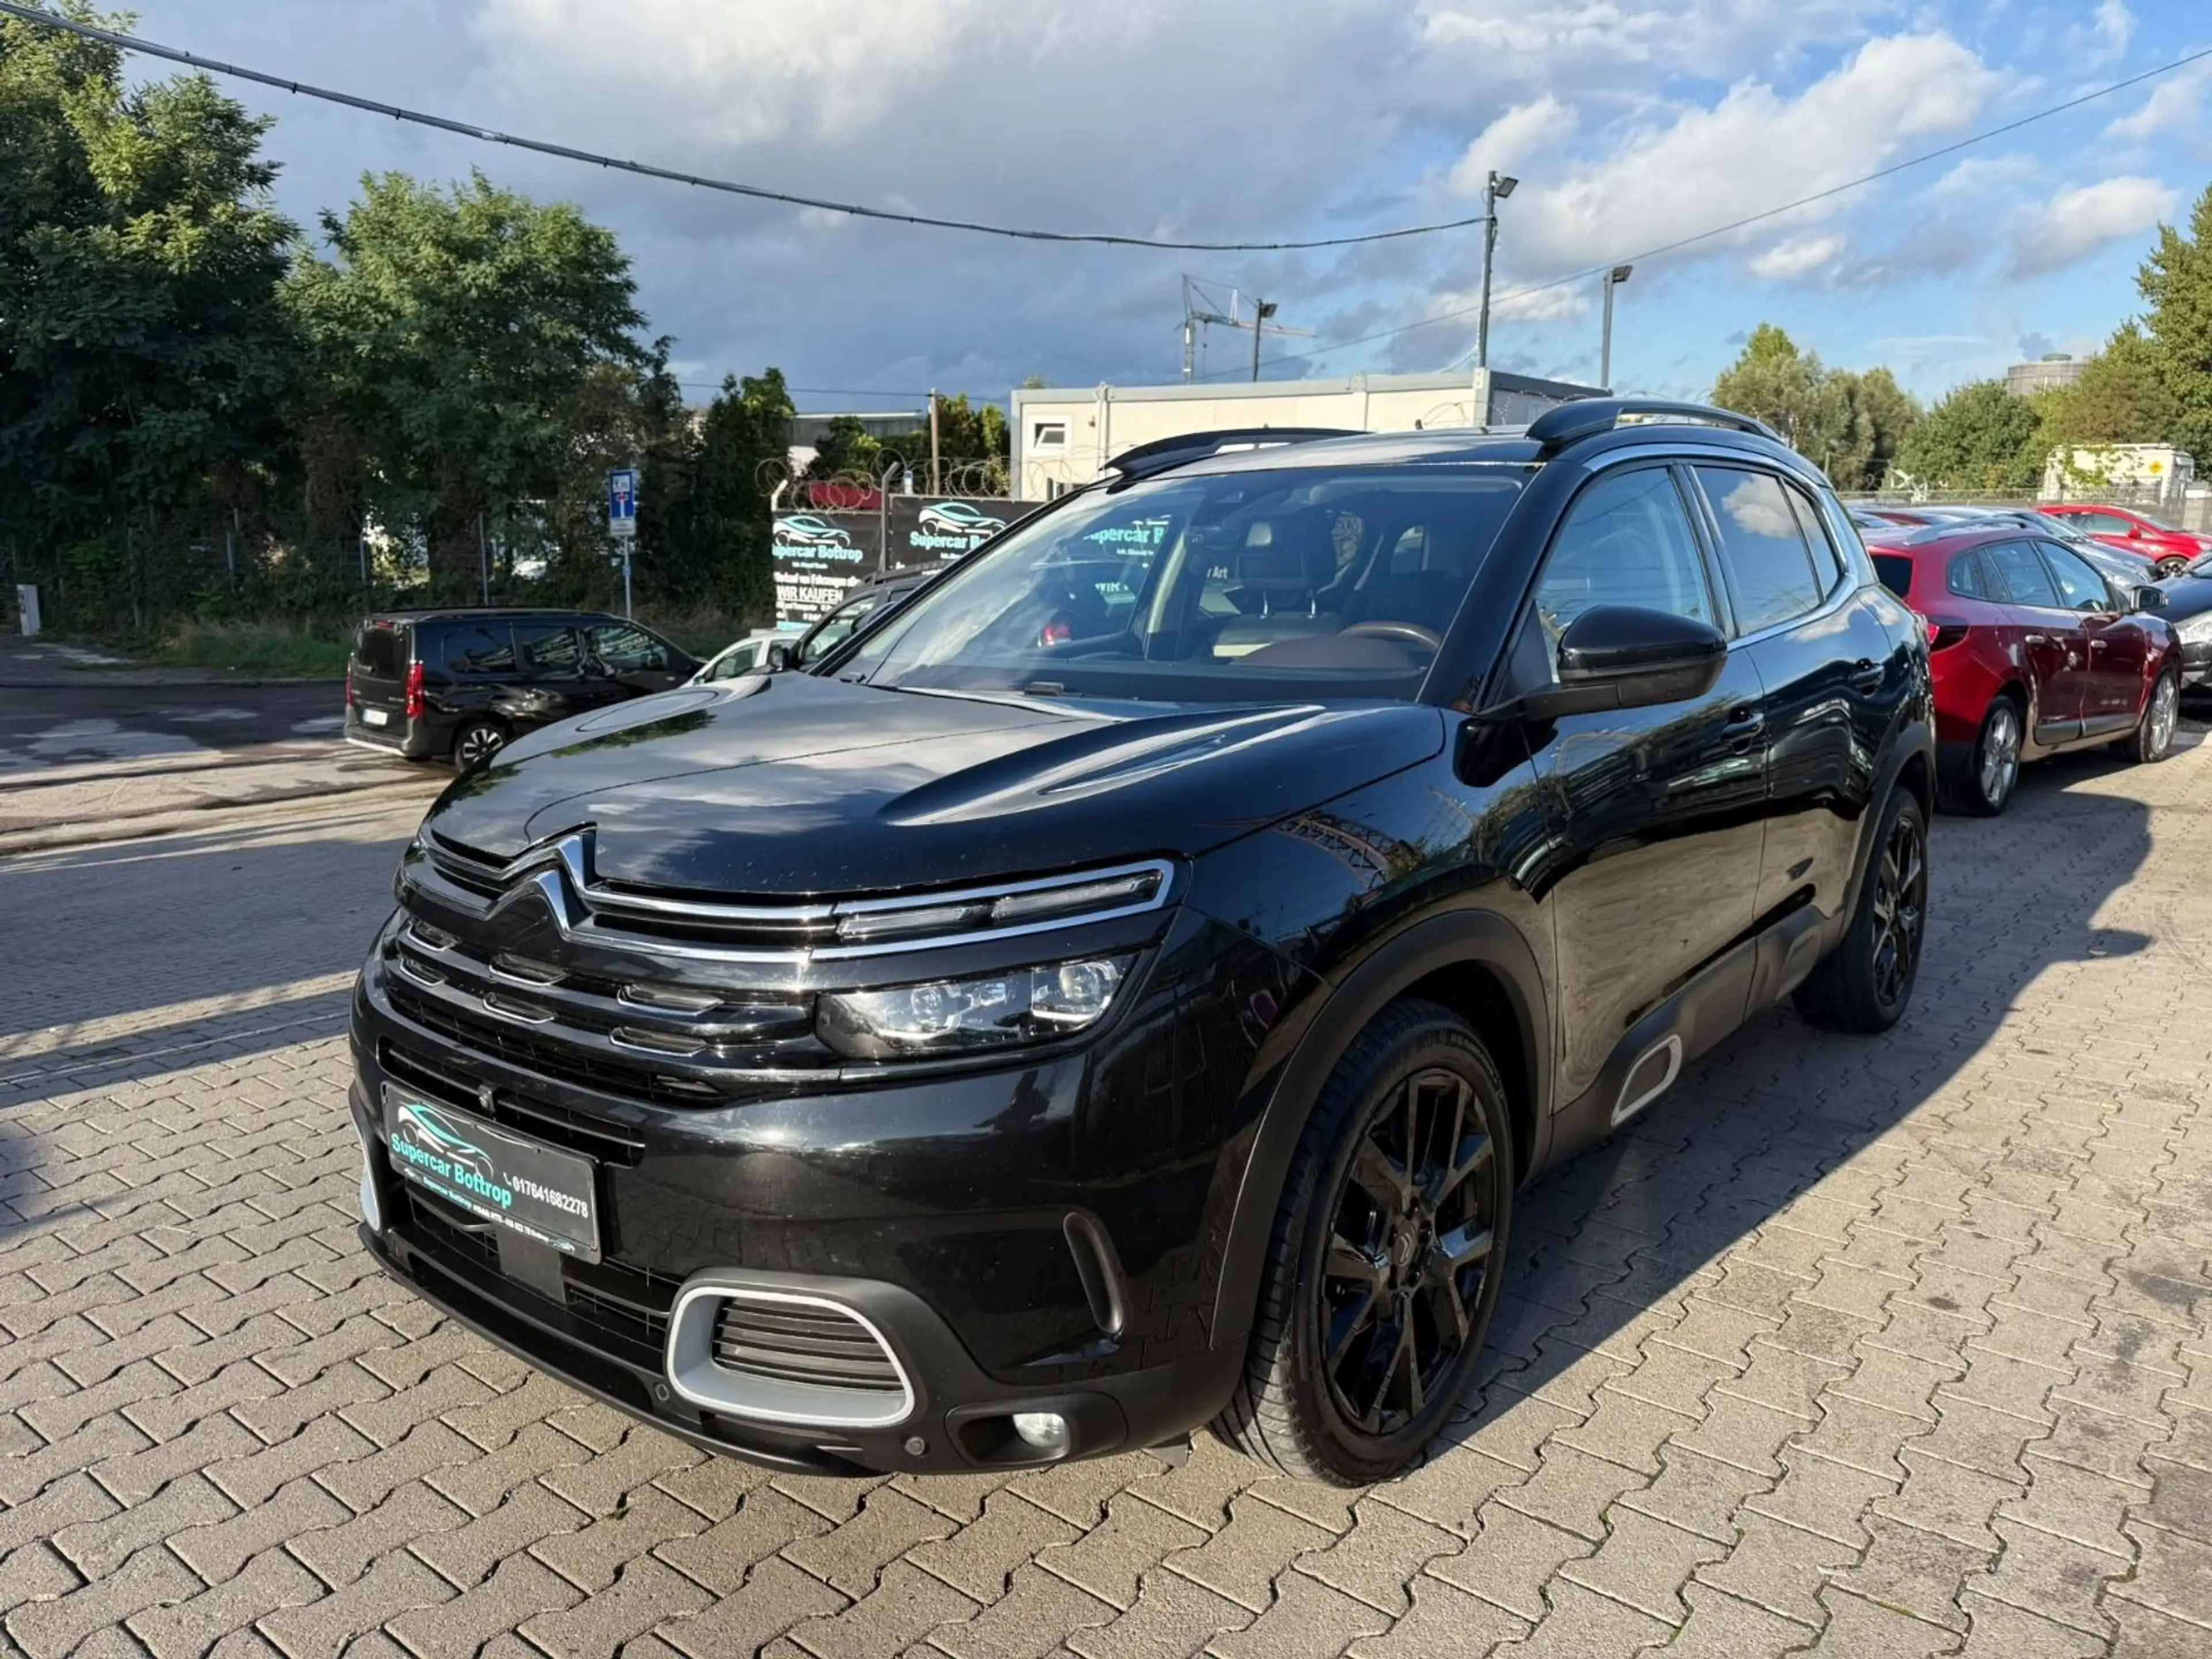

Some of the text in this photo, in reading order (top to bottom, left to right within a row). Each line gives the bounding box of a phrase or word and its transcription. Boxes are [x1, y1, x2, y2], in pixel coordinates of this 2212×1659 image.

[910, 531, 968, 550] Supercar
[818, 545, 863, 563] Bottrop
[777, 585, 844, 604] WIR KAUFEN
[391, 1132, 452, 1177] Supercar
[453, 1162, 512, 1209] Bottrop
